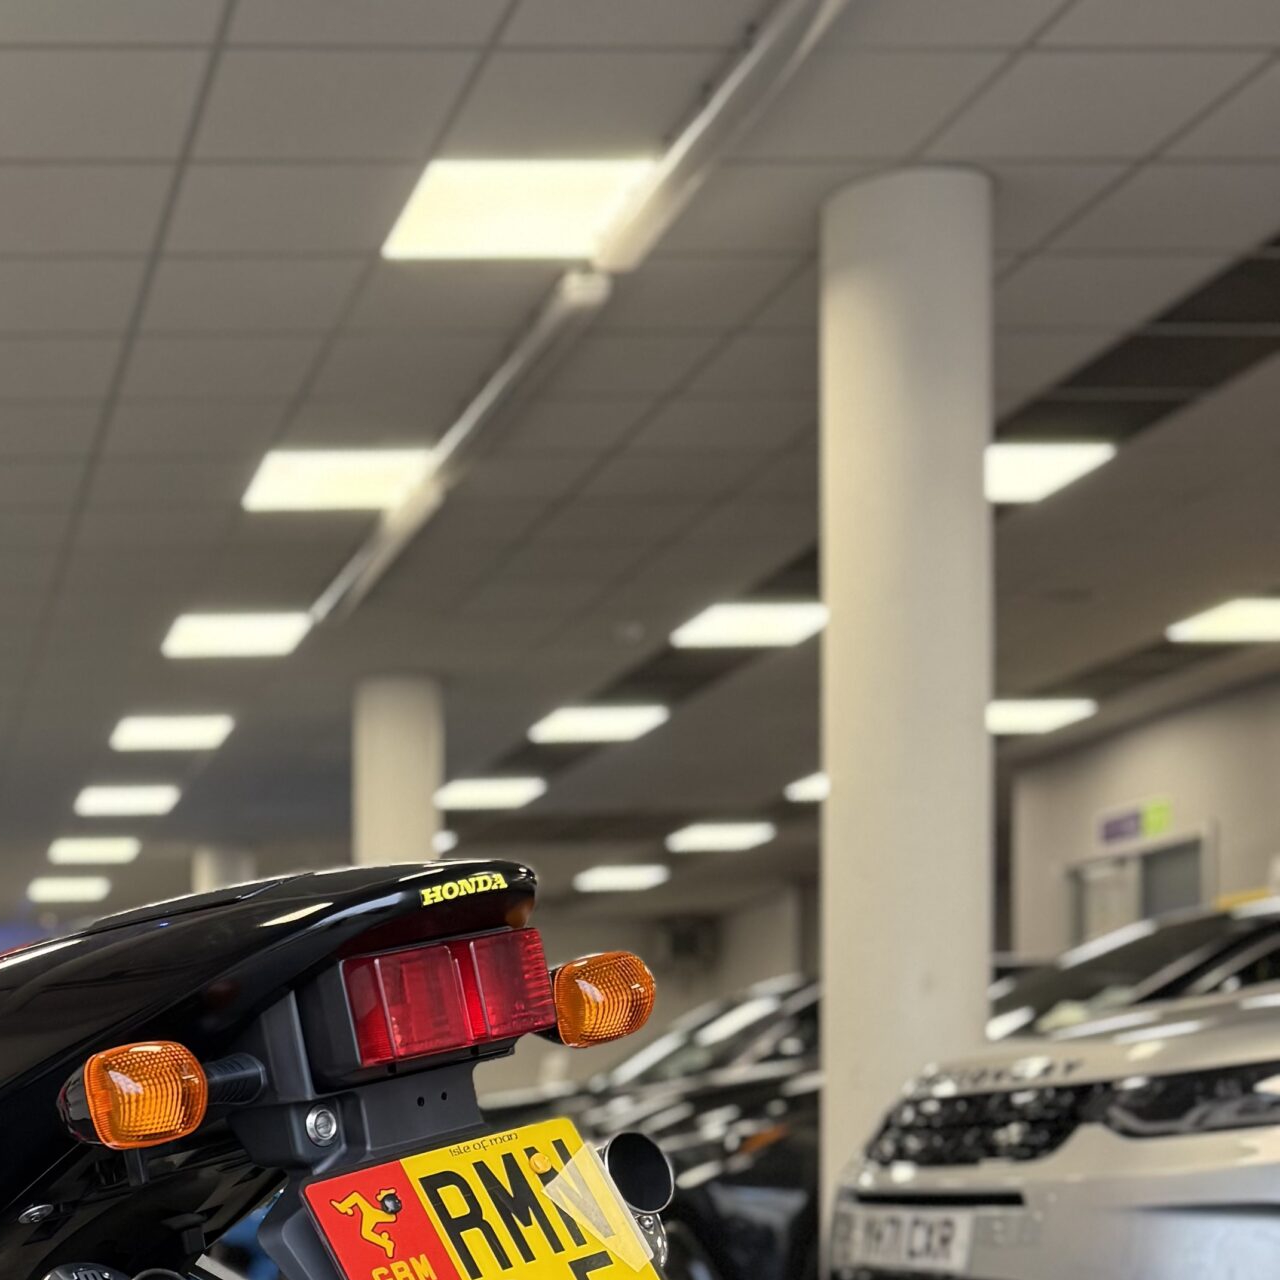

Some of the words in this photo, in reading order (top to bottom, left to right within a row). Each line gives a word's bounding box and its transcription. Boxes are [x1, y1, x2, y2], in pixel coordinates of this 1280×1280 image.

[421, 873, 508, 906] HONDA
[449, 1145, 471, 1157] Isle
[473, 1140, 489, 1151] of
[419, 1139, 616, 1280] RMN
